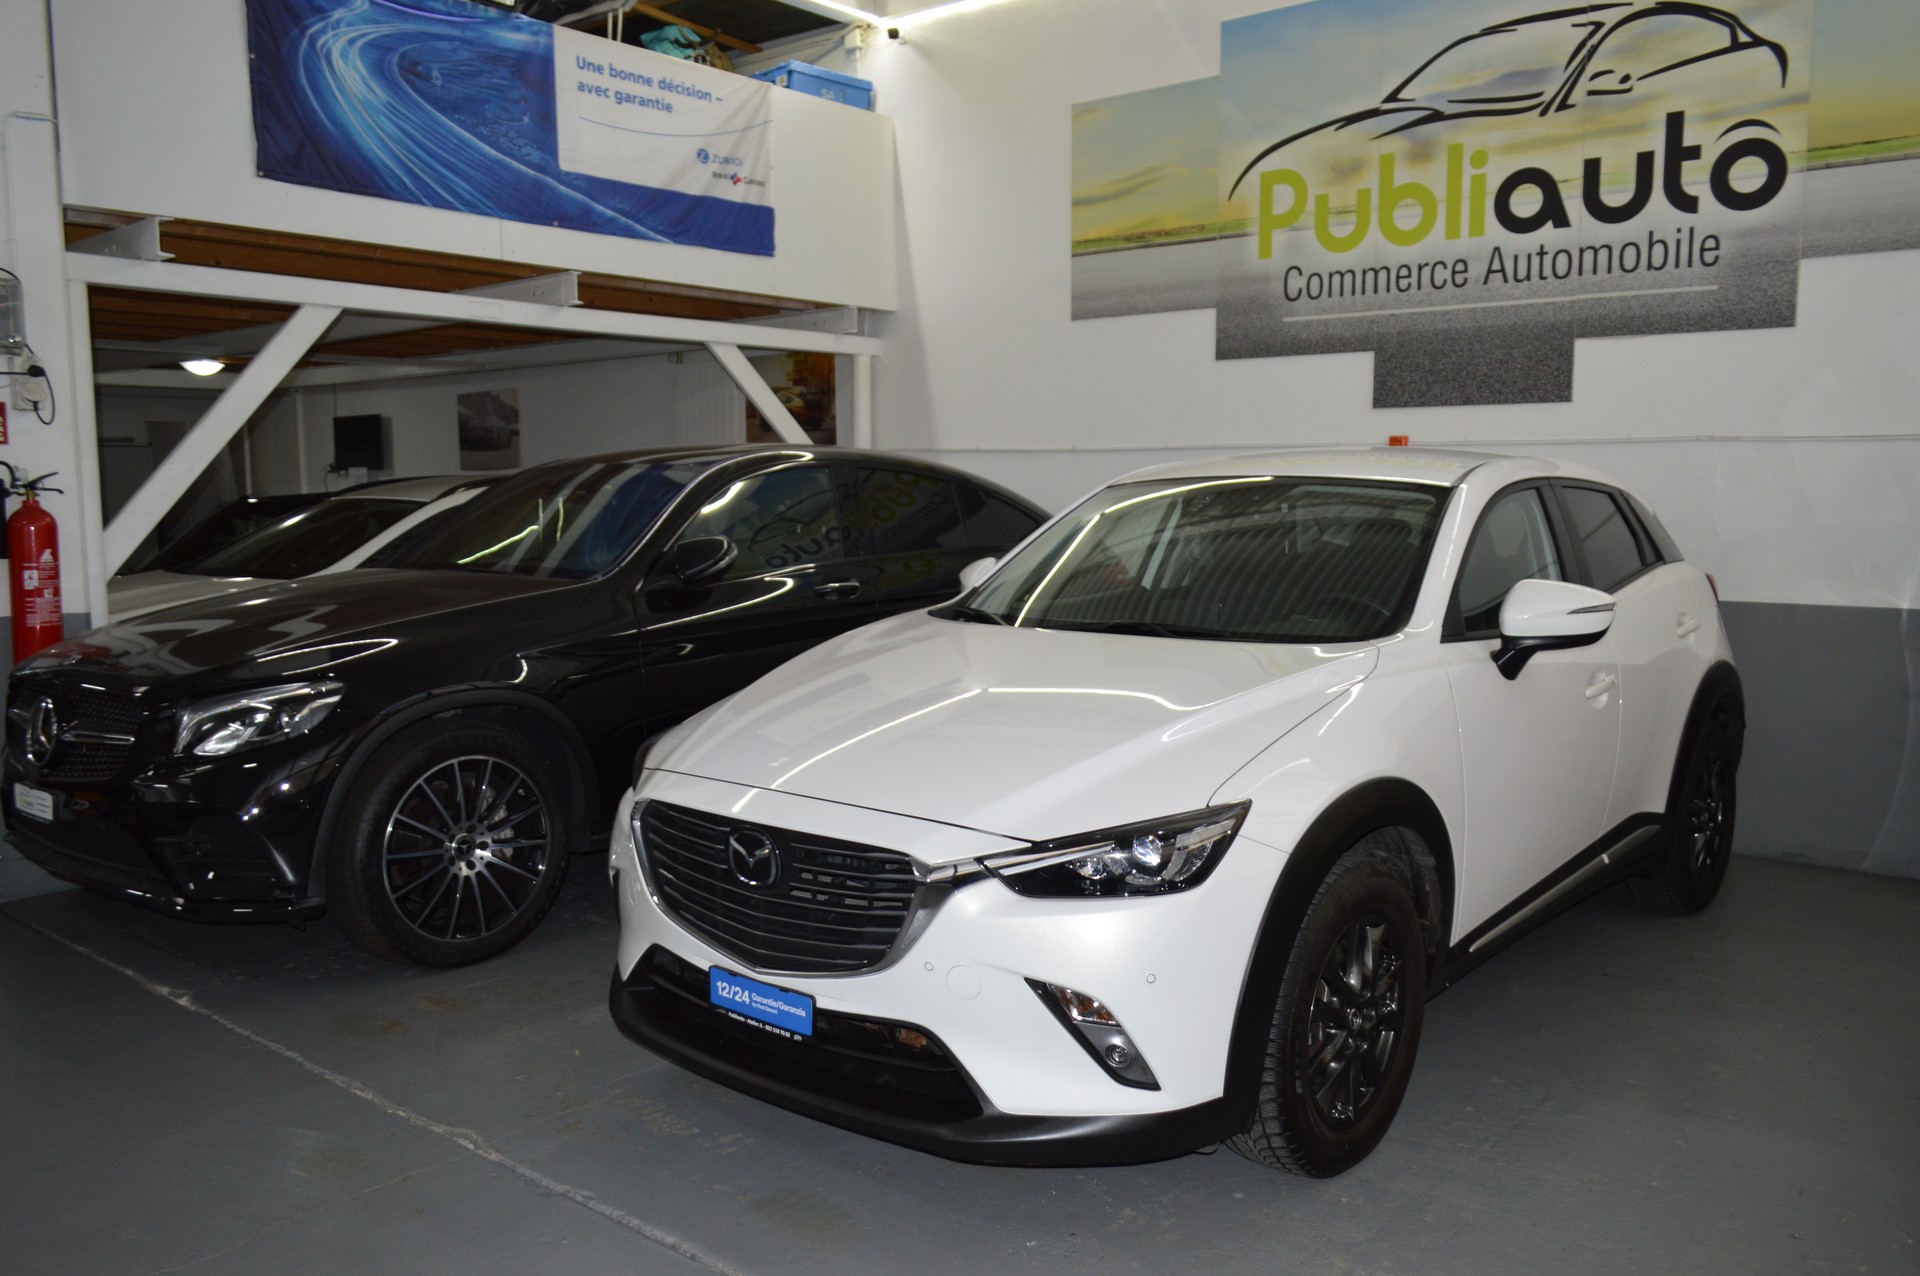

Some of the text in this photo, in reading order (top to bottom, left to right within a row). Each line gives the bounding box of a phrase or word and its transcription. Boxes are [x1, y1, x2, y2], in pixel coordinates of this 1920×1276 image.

[576, 55, 605, 75] Une
[608, 63, 654, 88] bonne
[658, 77, 713, 103] décision
[577, 80, 673, 113] avec garantie
[1283, 226, 1721, 302] Commerce Automobile
[716, 980, 807, 1017] 12/24 Garantie/Garanzia
